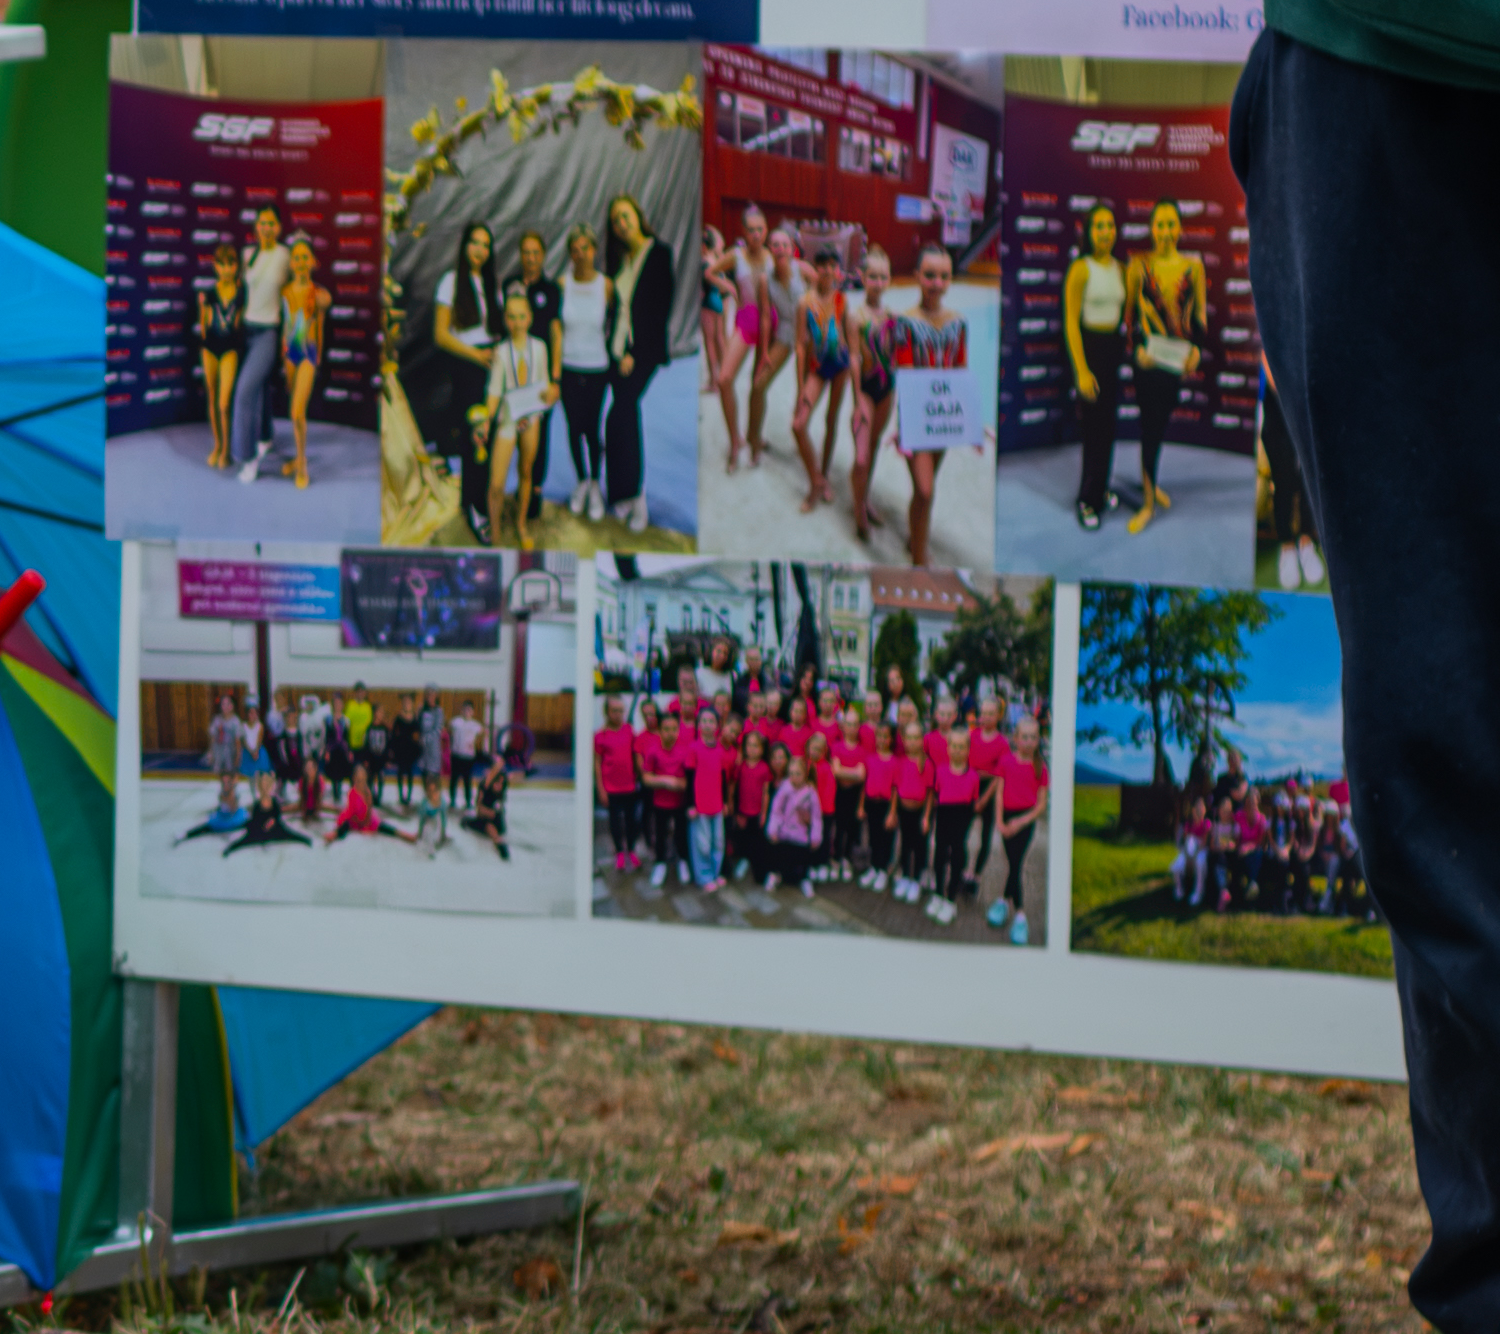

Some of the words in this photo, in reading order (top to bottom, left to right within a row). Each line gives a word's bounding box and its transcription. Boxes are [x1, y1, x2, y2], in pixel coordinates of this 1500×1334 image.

[1122, 3, 1240, 32] Facebook:
[192, 112, 276, 145] SGF
[1071, 120, 1162, 155] SGF
